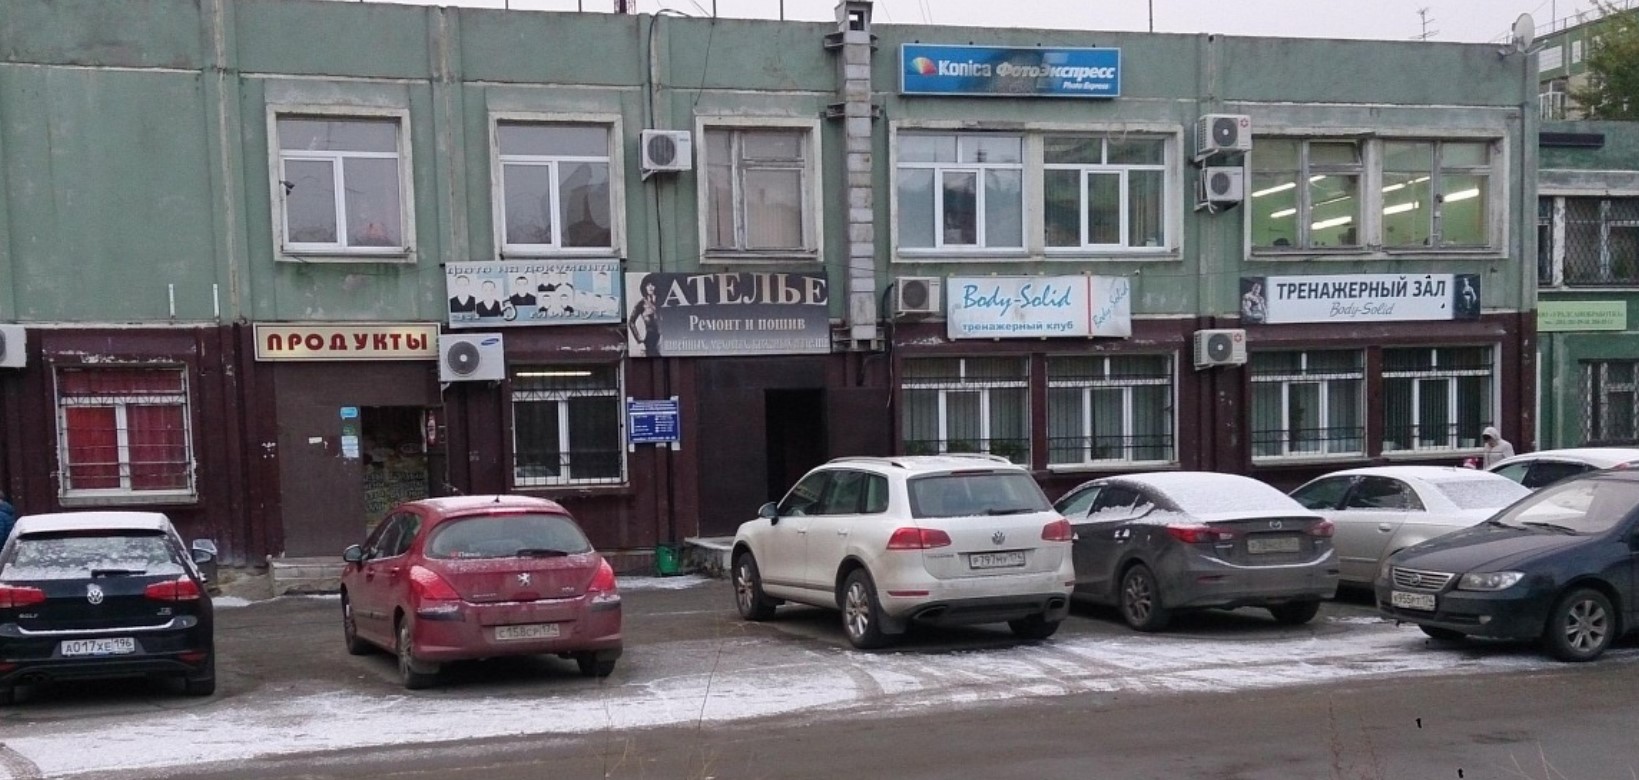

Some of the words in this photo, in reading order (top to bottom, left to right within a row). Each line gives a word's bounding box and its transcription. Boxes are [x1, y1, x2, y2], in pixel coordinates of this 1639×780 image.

[938, 60, 992, 77] Konica
[996, 61, 1115, 81] ФотоЭкспресс
[661, 272, 828, 308] АТЕЛЬЕ
[1277, 275, 1408, 300] ТРЕНАЖЕРНЫЙ
[1413, 280, 1446, 297] ЗАЛ
[963, 283, 1071, 316] Body-Solid
[500, 298, 518, 322] 5
[1329, 302, 1395, 317] Body-Solid
[689, 315, 741, 331] Ремонт
[745, 319, 753, 331] и
[758, 318, 806, 331] пошив
[963, 321, 1043, 333] тренажерный
[1046, 321, 1073, 332] клуб
[267, 333, 427, 350] ПРОДУКТЫ
[65, 640, 111, 653] А017ХЕ
[114, 639, 132, 649] 196
